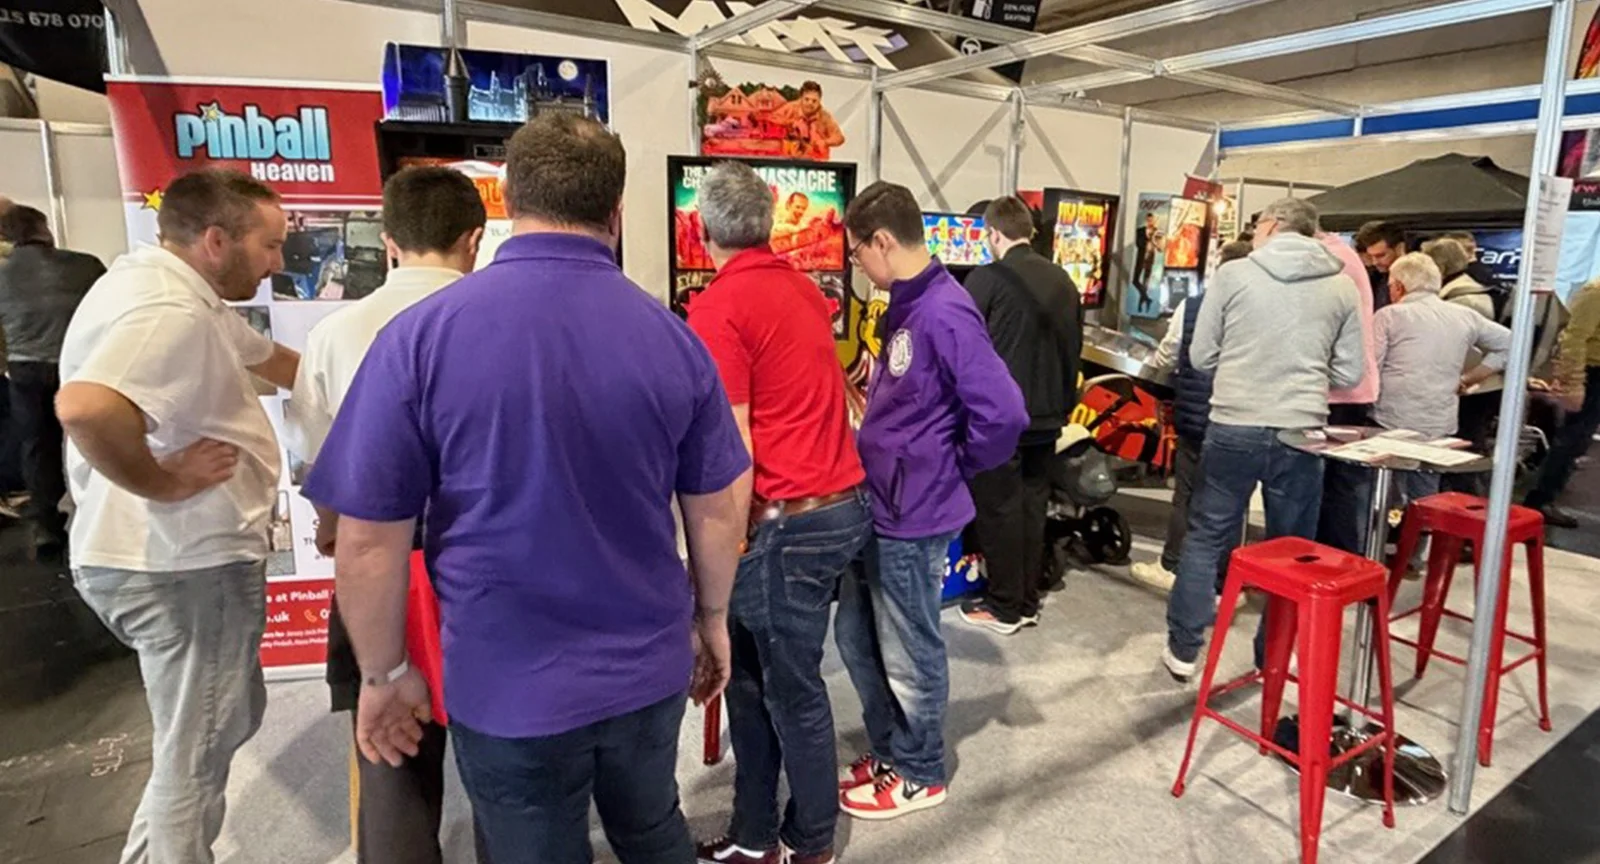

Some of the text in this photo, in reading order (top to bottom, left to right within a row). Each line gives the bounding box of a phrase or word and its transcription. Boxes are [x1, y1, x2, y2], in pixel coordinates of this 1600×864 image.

[28, 11, 64, 28] 678
[174, 102, 331, 160] Pinball
[251, 162, 335, 182] Heaven
[275, 593, 288, 603] at
[290, 589, 329, 601] Pinball
